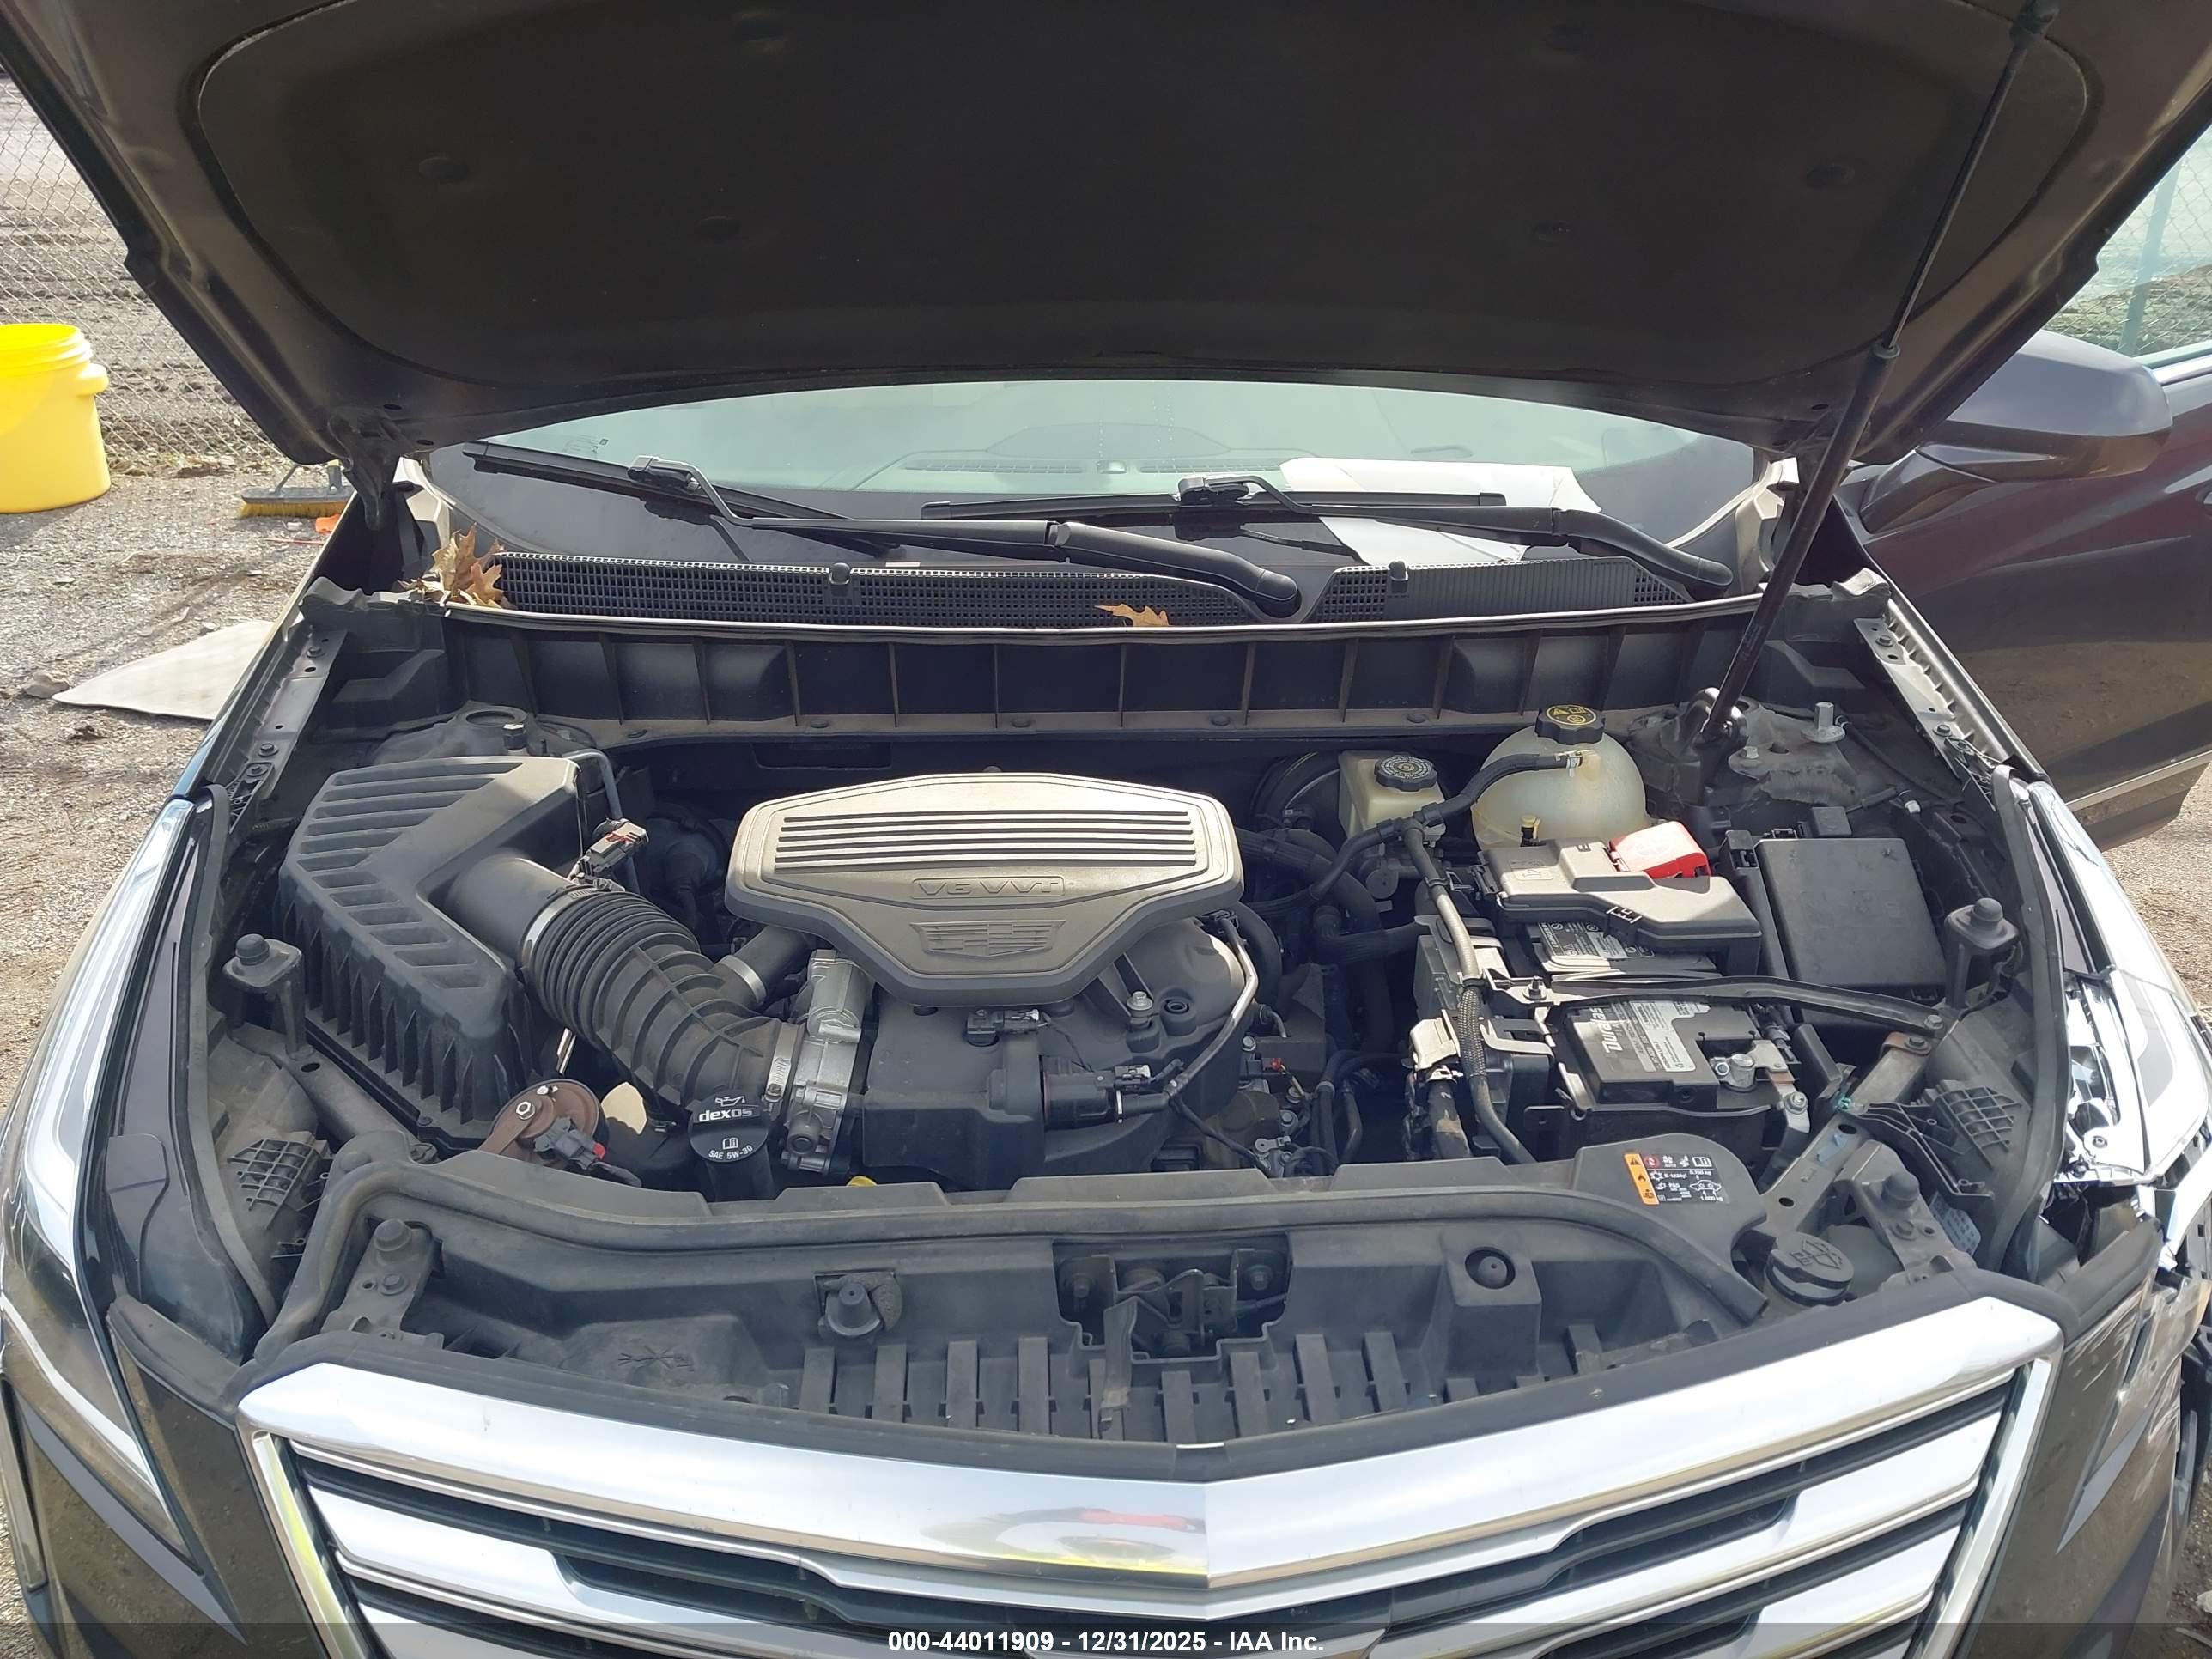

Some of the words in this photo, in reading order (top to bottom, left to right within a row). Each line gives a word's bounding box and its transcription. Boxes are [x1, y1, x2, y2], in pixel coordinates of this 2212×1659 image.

[918, 882, 971, 896] V6
[980, 879, 1059, 894] VVT
[1589, 1007, 1624, 1054] Duralas
[699, 1108, 753, 1121] dexos
[708, 1150, 723, 1159] SAE
[726, 1145, 753, 1159] 5W-30
